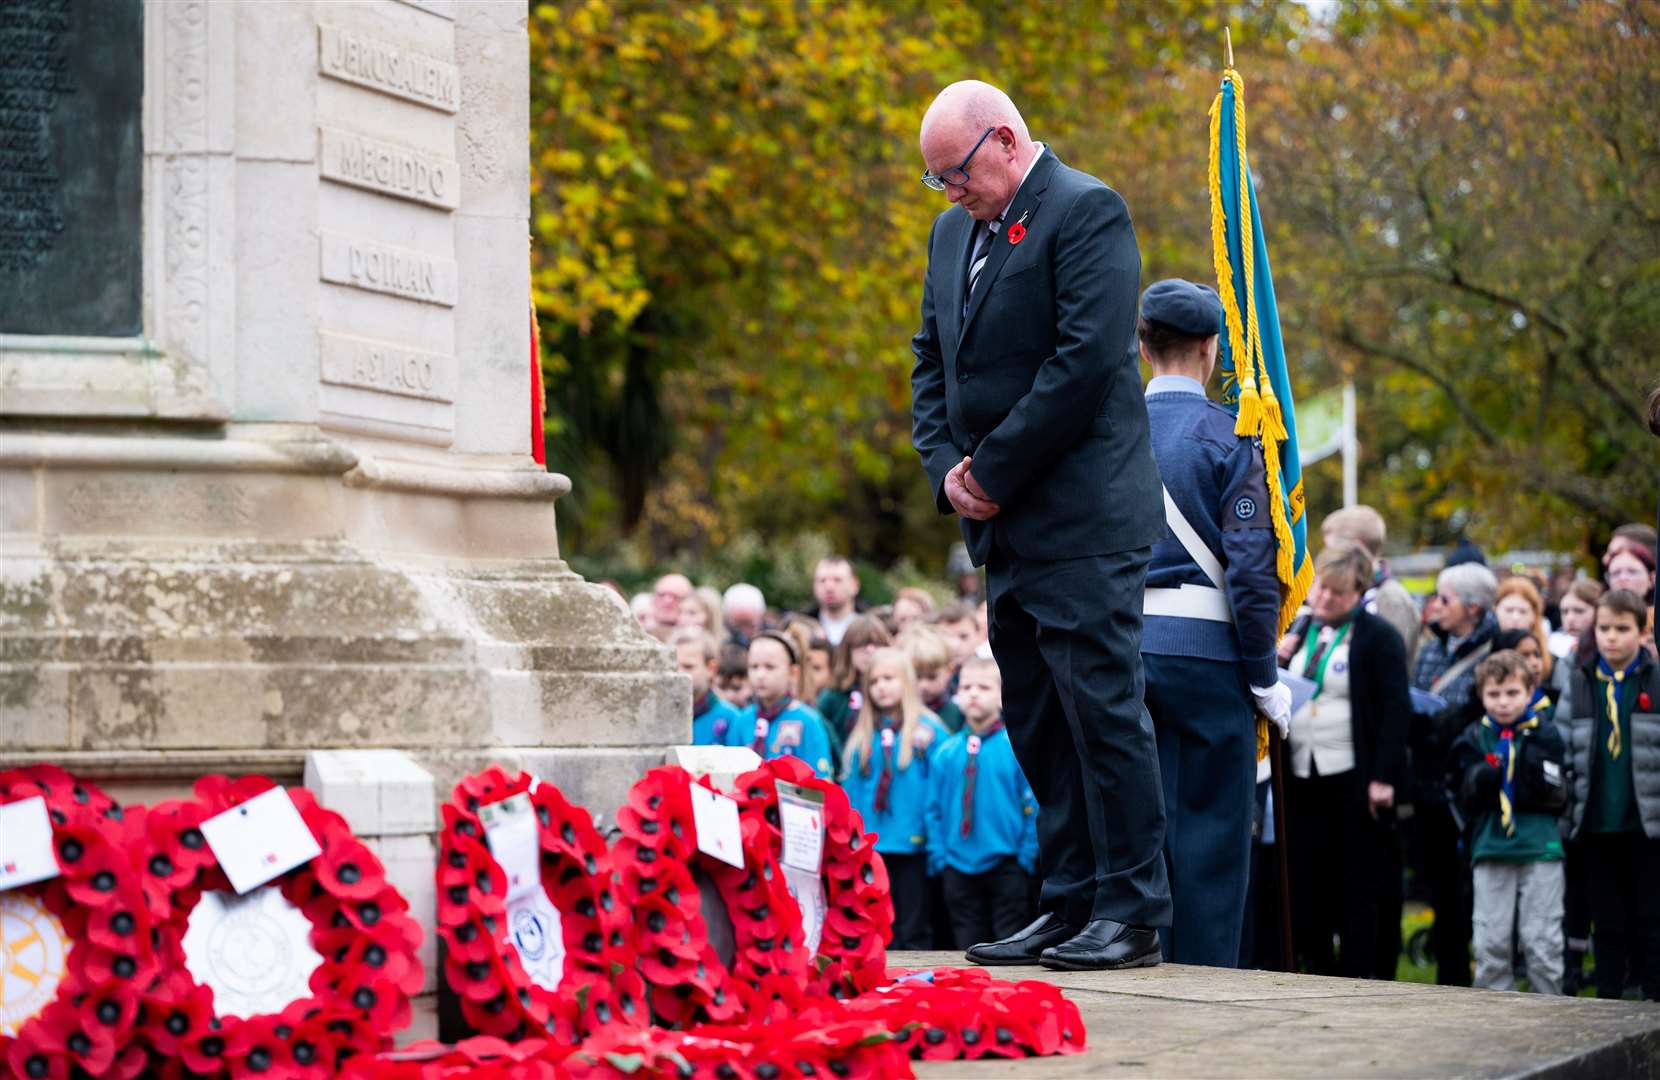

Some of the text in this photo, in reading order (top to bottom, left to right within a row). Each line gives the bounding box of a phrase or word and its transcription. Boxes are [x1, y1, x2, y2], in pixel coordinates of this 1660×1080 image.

[331, 30, 455, 105] JERUSALEM
[340, 141, 444, 198] MEGIDDO
[349, 245, 435, 295] DOIRAN
